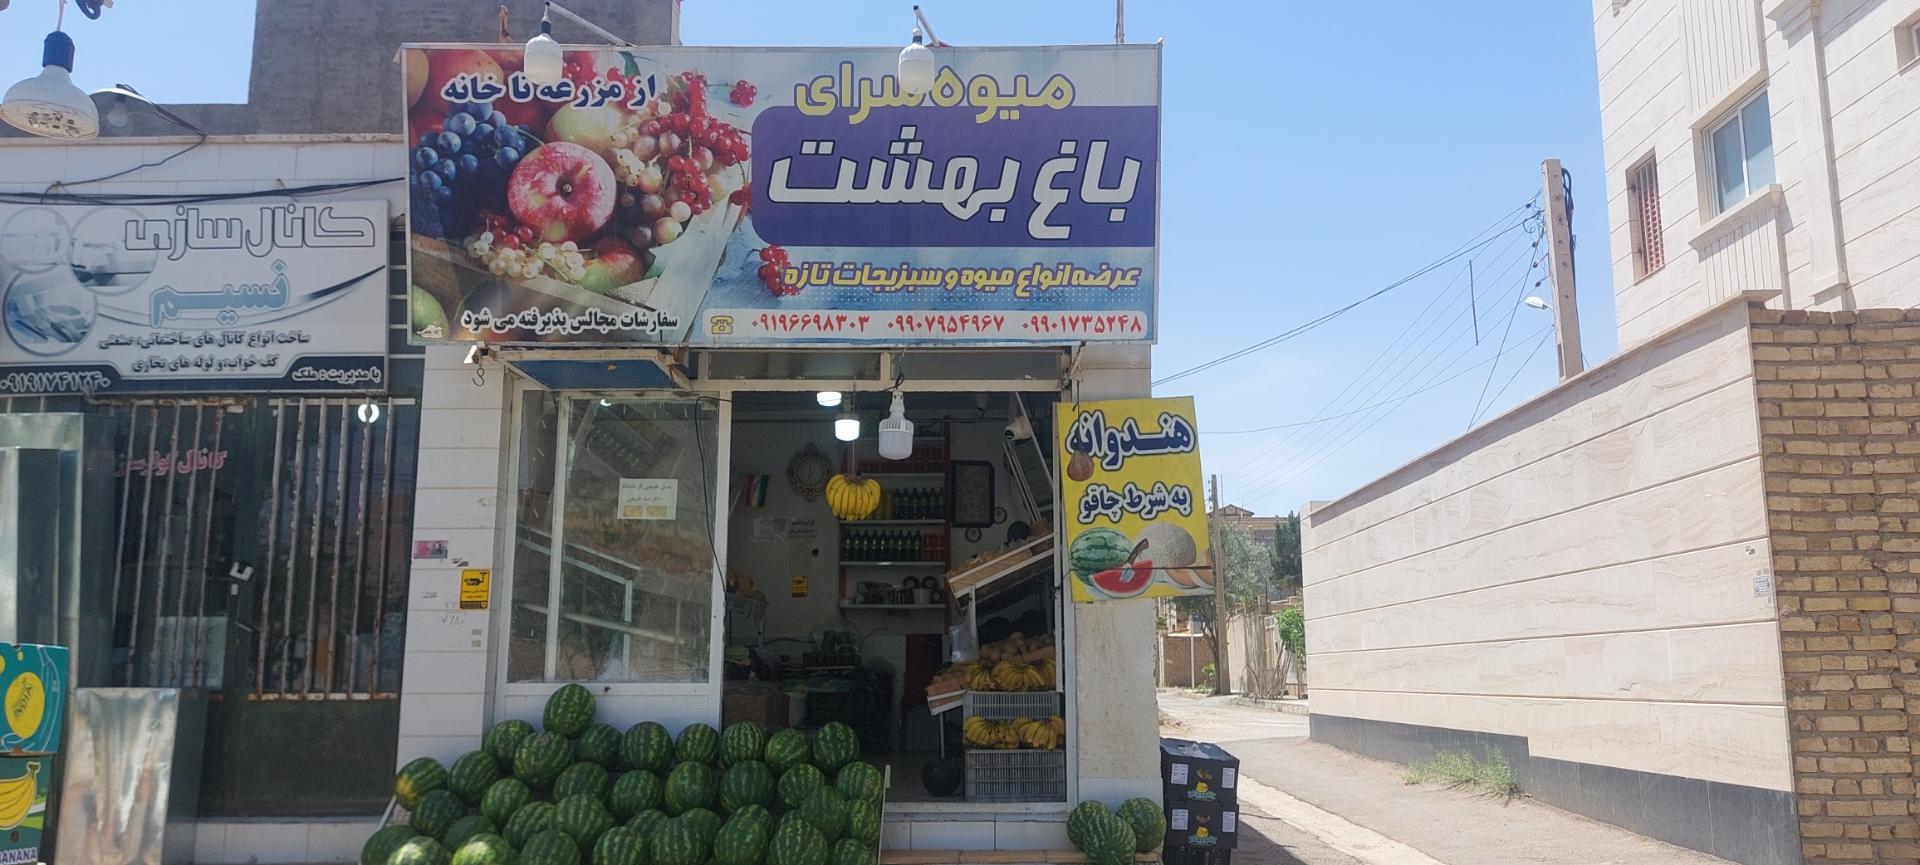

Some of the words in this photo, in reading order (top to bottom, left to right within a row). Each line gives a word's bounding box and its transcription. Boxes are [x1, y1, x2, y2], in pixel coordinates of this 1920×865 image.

[443, 75, 503, 102] خانه
[537, 77, 622, 108] مزرعه
[628, 73, 657, 108] از
[795, 61, 926, 124] سرای
[930, 66, 1075, 124] میوه
[768, 125, 1021, 222] بهشت
[1027, 140, 1142, 240] باغ
[125, 205, 243, 260] سازی
[245, 204, 375, 258] کانال
[784, 262, 832, 289] تازه
[832, 262, 943, 292] سبزیجات
[944, 267, 959, 291] و
[960, 267, 1014, 292] میوه
[1015, 262, 1071, 297] انواع
[1071, 262, 1141, 290] عرضه
[149, 260, 290, 328] نسیم
[462, 308, 491, 334] شود
[494, 312, 515, 332] می
[519, 308, 567, 335] پذیرفته
[570, 309, 617, 334] مجالس
[620, 309, 679, 334] سفارشات
[752, 313, 870, 332] ۰۹۱۹۶۶۹۸۳۰۳
[887, 314, 1004, 333] ۰۹۹۰۷۹۵۴۹۶۷
[193, 331, 215, 348] های
[217, 331, 246, 347] کانال
[248, 331, 274, 347] انواع
[276, 330, 310, 344] ساخت
[132, 355, 165, 373] بخاری
[168, 355, 190, 372] های
[194, 354, 214, 371] لوله
[260, 354, 279, 368] کف
[370, 366, 381, 383] با
[1066, 409, 1196, 471] هندوانه
[1078, 483, 1122, 524] چاقو
[1122, 481, 1169, 520] شرط
[1170, 484, 1192, 516] به
[0, 847, 38, 863] ANANA
